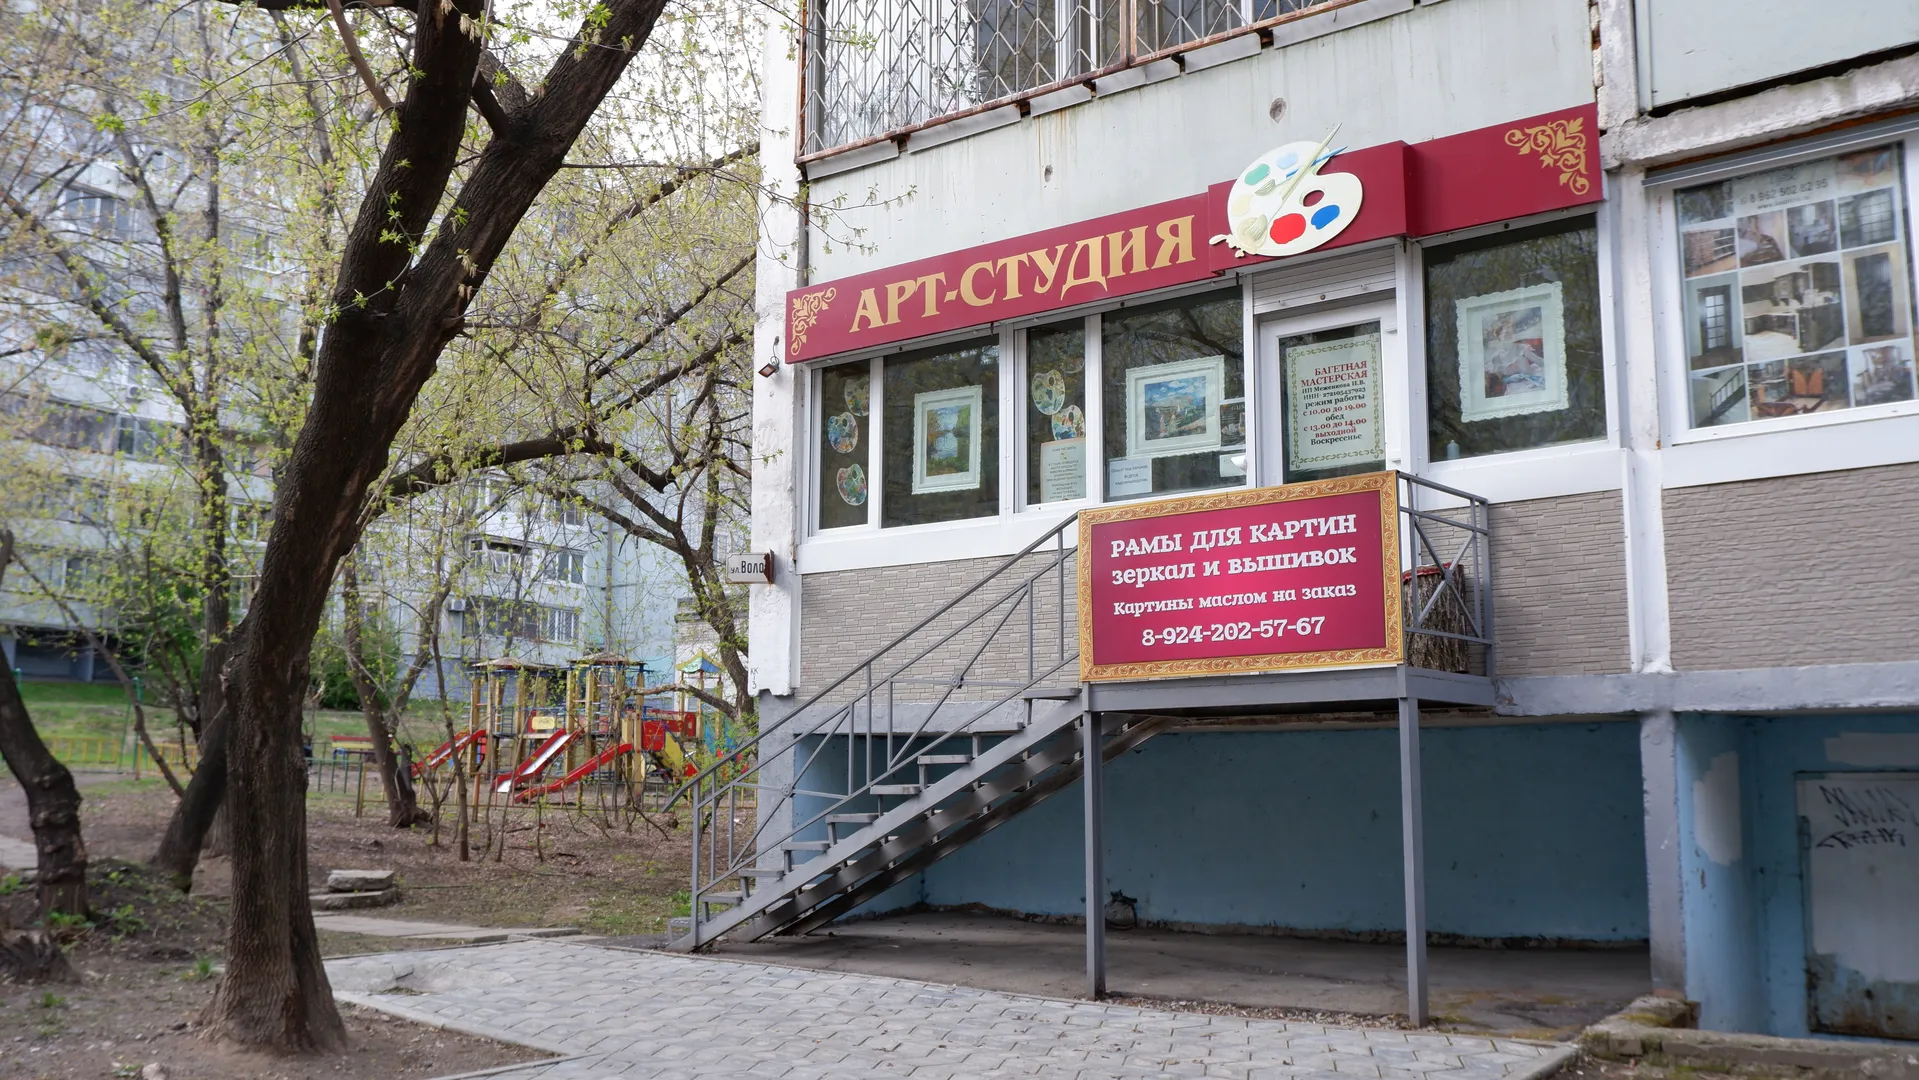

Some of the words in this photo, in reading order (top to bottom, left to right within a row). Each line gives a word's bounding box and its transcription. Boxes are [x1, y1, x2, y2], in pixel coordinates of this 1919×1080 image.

[849, 214, 1196, 333] АРТ-СТУДИЯ
[1314, 361, 1367, 376] БАГЕТНАЯ
[1301, 370, 1368, 387] МАСТЕРСКАЯ
[1305, 399, 1332, 409] режим
[1334, 394, 1365, 405] работы
[1344, 402, 1367, 411] 19.00
[1310, 423, 1331, 431] 13.00
[1345, 418, 1367, 427] 14.00
[1325, 413, 1345, 421] обед
[1310, 434, 1362, 445] Воскресенье
[1315, 426, 1356, 438] выходной
[1110, 533, 1182, 558] РАМЫ
[1190, 527, 1242, 553] ДЛЯ
[1249, 513, 1357, 544] КАРТИН
[1112, 562, 1195, 587] зеркал
[1203, 560, 1220, 577] и
[1228, 546, 1357, 575] вышивок
[1113, 597, 1194, 617] Картины
[1199, 590, 1267, 609] маслом
[1272, 589, 1296, 602] на
[1302, 583, 1357, 601] заказ
[1141, 616, 1326, 646] 8-924-202-57-67
